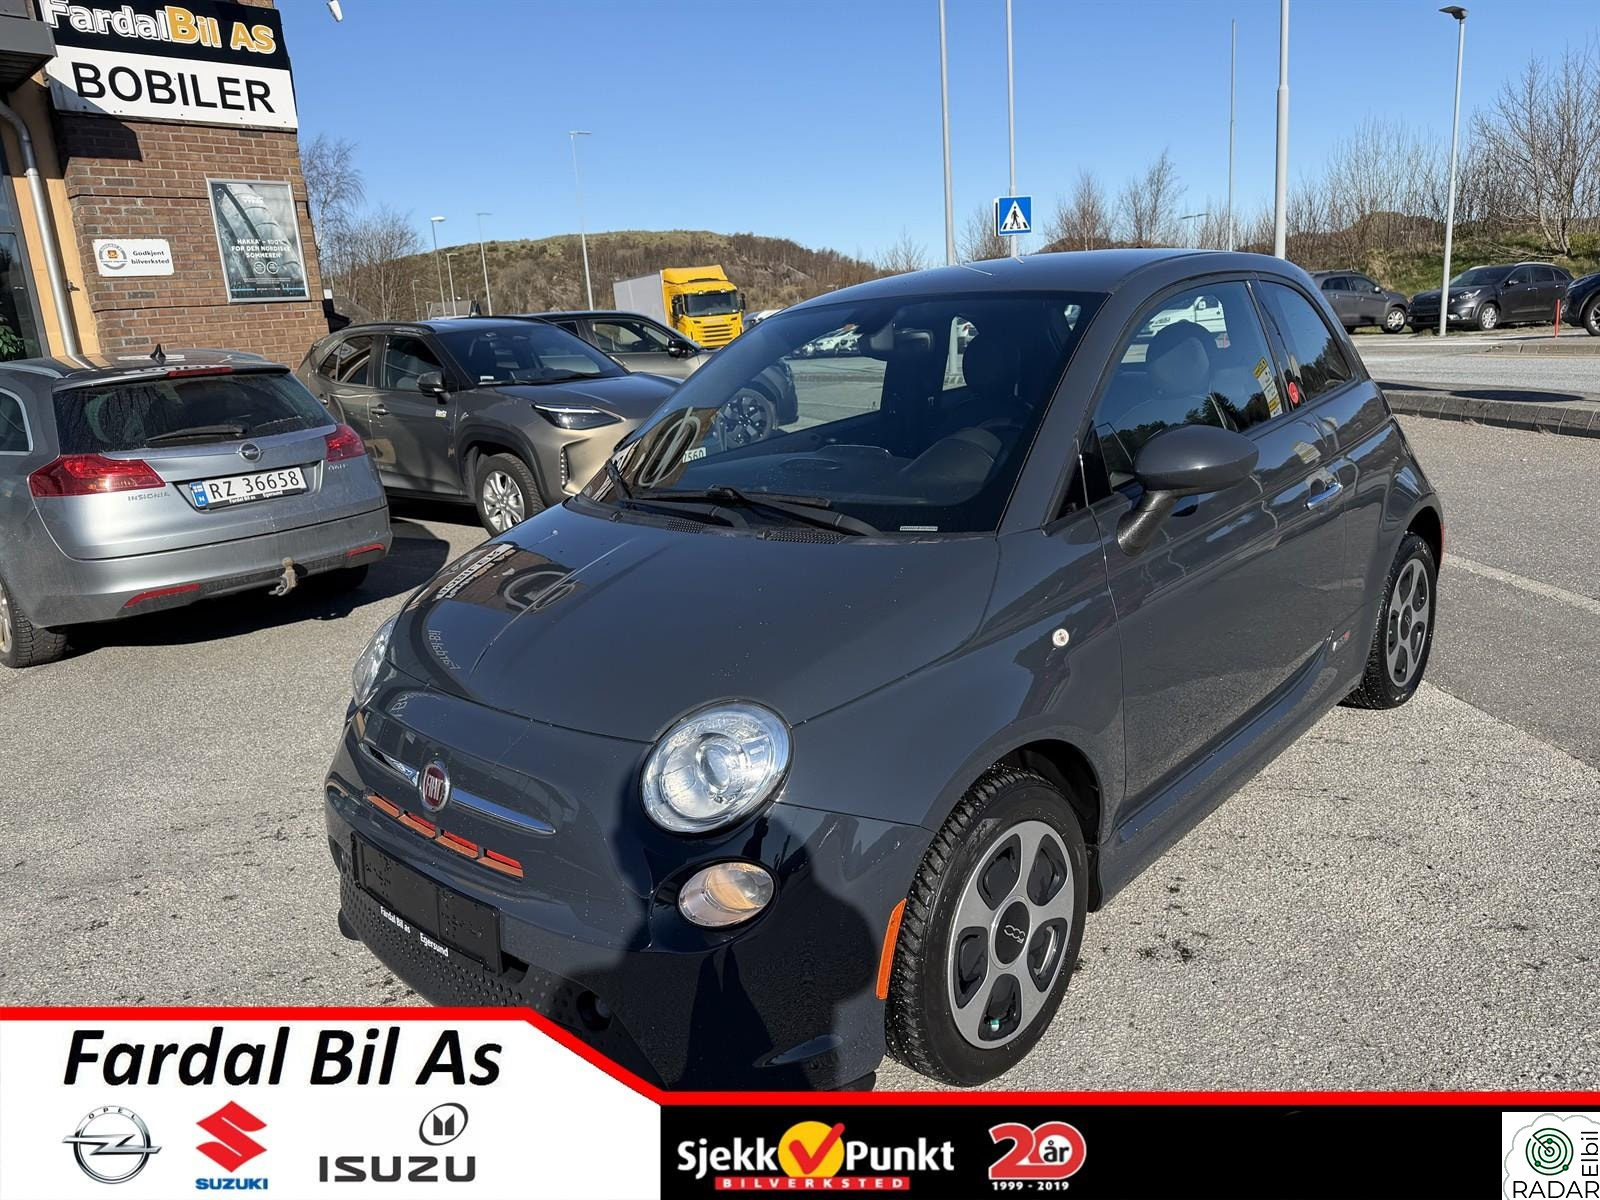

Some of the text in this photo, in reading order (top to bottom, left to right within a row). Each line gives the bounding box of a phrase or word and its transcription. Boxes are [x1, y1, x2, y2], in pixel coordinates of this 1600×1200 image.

[231, 21, 277, 54] AS
[71, 61, 276, 114] BOBILER
[127, 492, 171, 502] INSIGNIA
[208, 469, 300, 500] RZ 36658
[425, 773, 444, 801] FIAT
[380, 905, 397, 924] Fardal
[419, 932, 449, 957] Egersund
